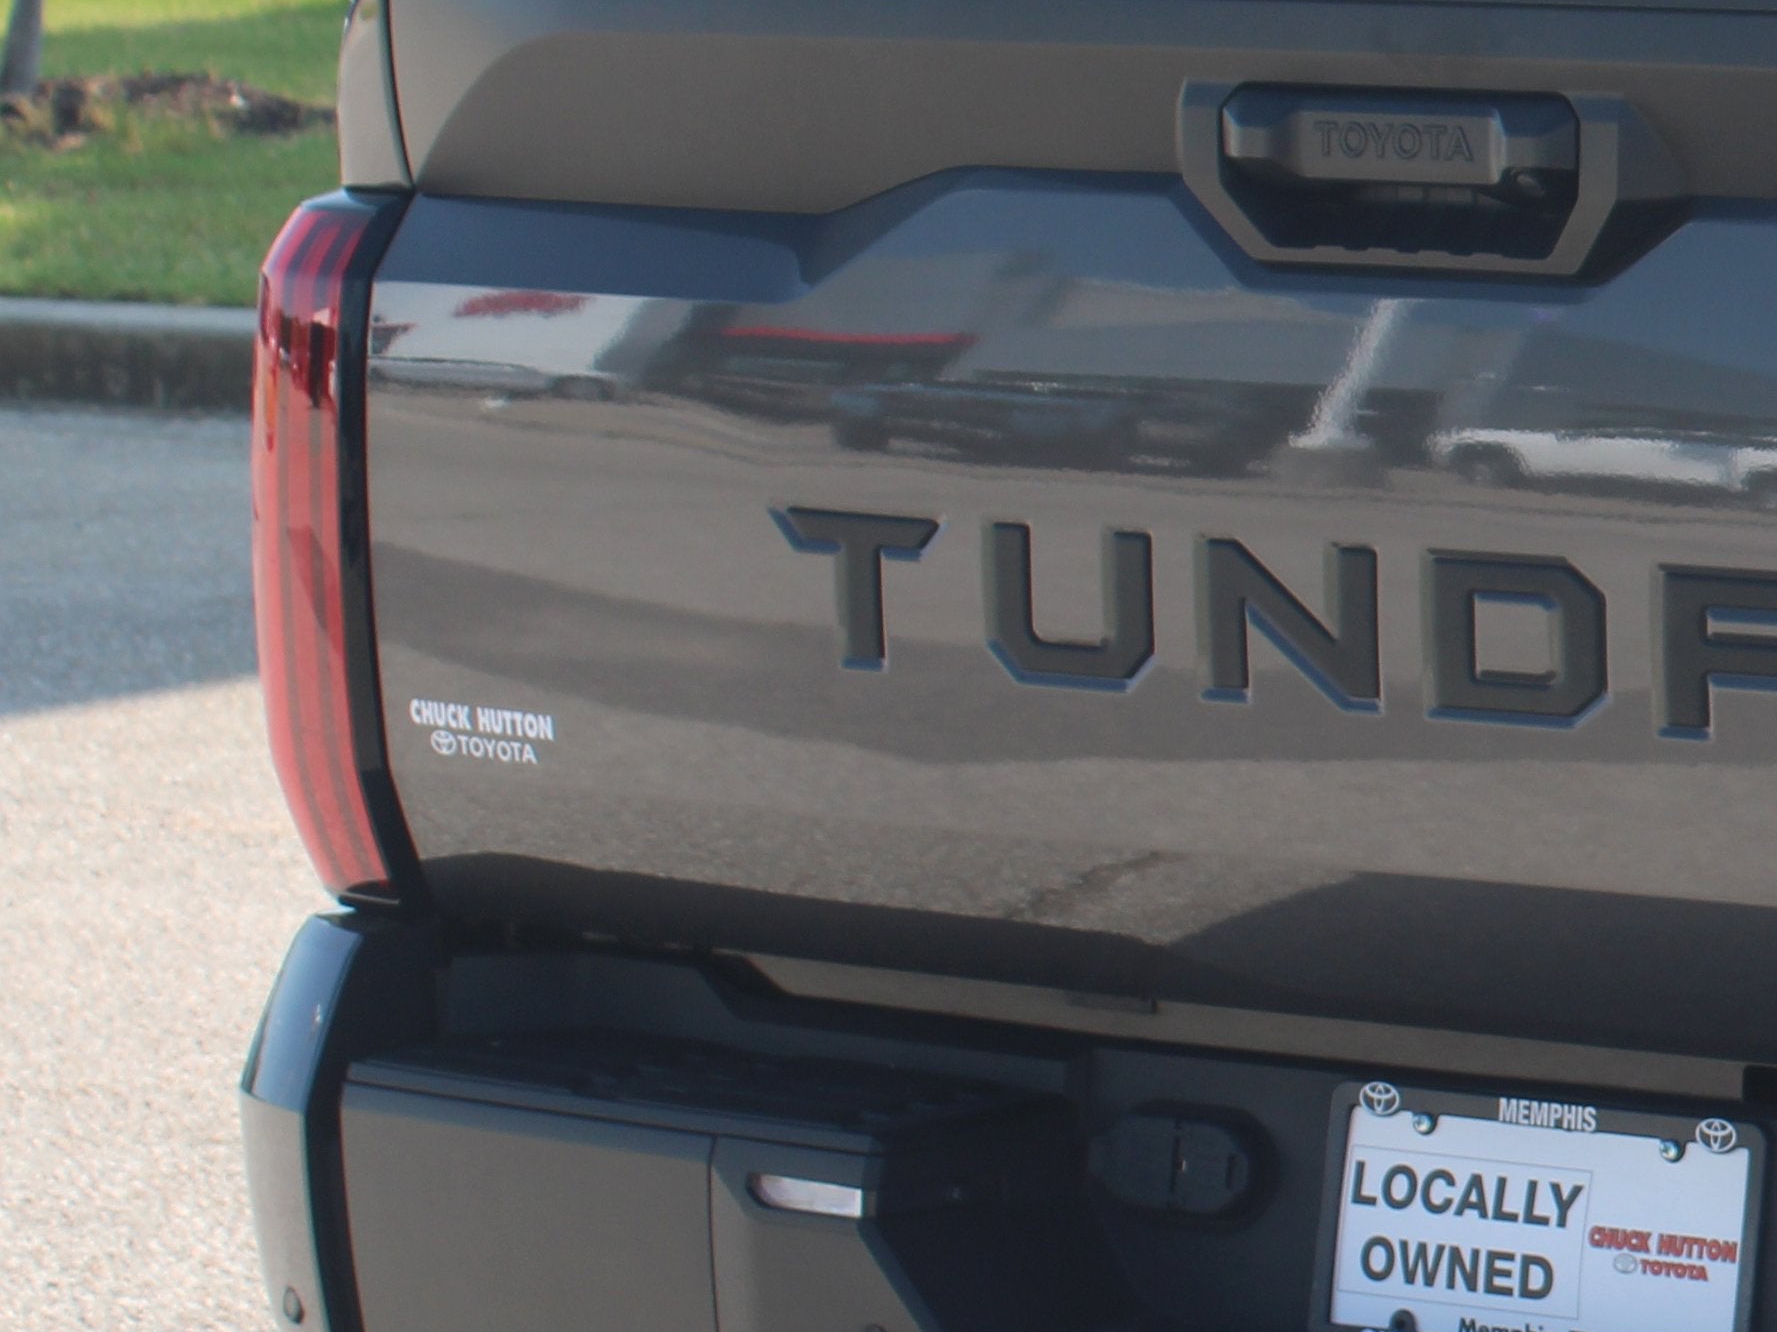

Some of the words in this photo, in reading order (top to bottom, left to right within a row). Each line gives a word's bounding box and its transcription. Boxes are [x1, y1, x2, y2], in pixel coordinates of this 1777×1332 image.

[1315, 120, 1475, 162] TOYOTA
[409, 698, 473, 730] CHUCK
[476, 706, 555, 741] HUTTON
[458, 734, 538, 764] TOYOTA
[1499, 1097, 1597, 1132] MEMPHIS
[1351, 1160, 1584, 1229] LOCALLY
[1588, 1226, 1651, 1254] CHUCK
[1657, 1234, 1738, 1264] HUTTON
[1360, 1235, 1555, 1300] OWNED
[1640, 1262, 1709, 1282] TOYOTA
